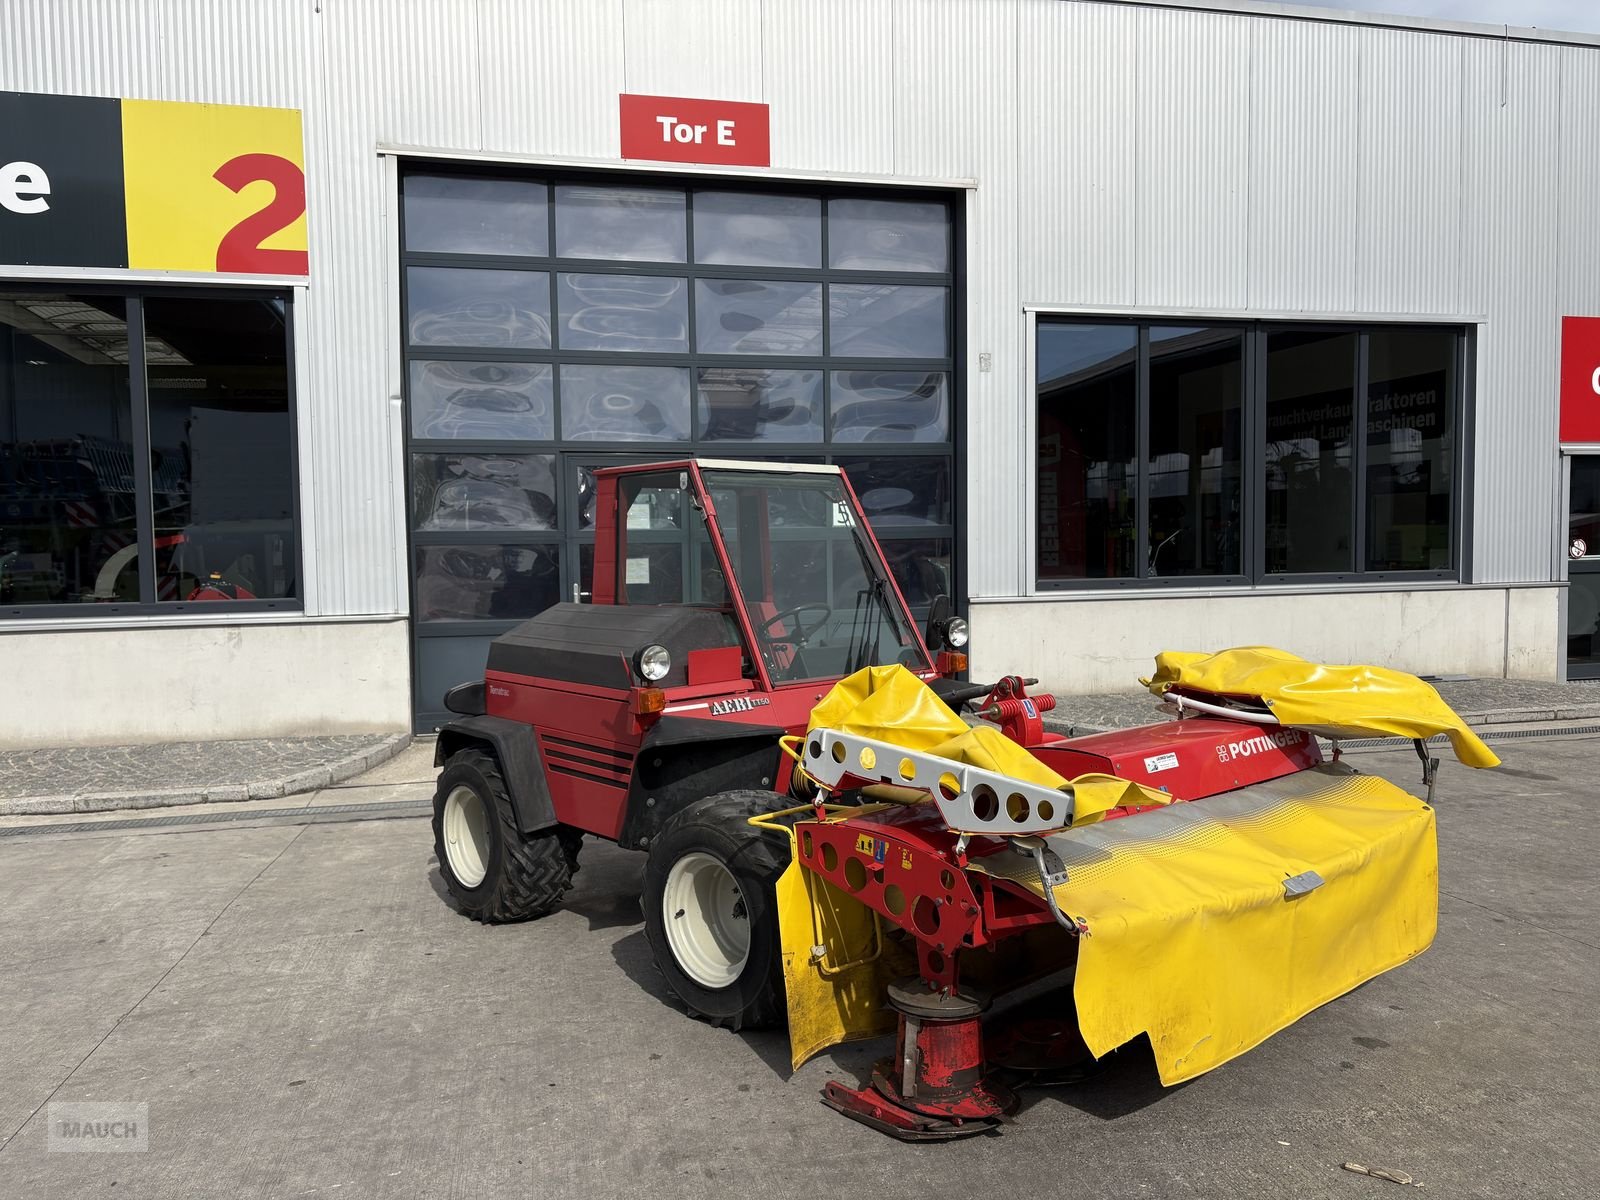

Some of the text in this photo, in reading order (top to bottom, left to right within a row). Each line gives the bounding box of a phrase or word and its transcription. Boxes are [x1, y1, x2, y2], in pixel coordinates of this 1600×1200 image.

[656, 115, 736, 146] Tor E
[212, 153, 309, 276] 2
[1268, 403, 1354, 428] rauchtverkau
[712, 696, 754, 716] AEBI
